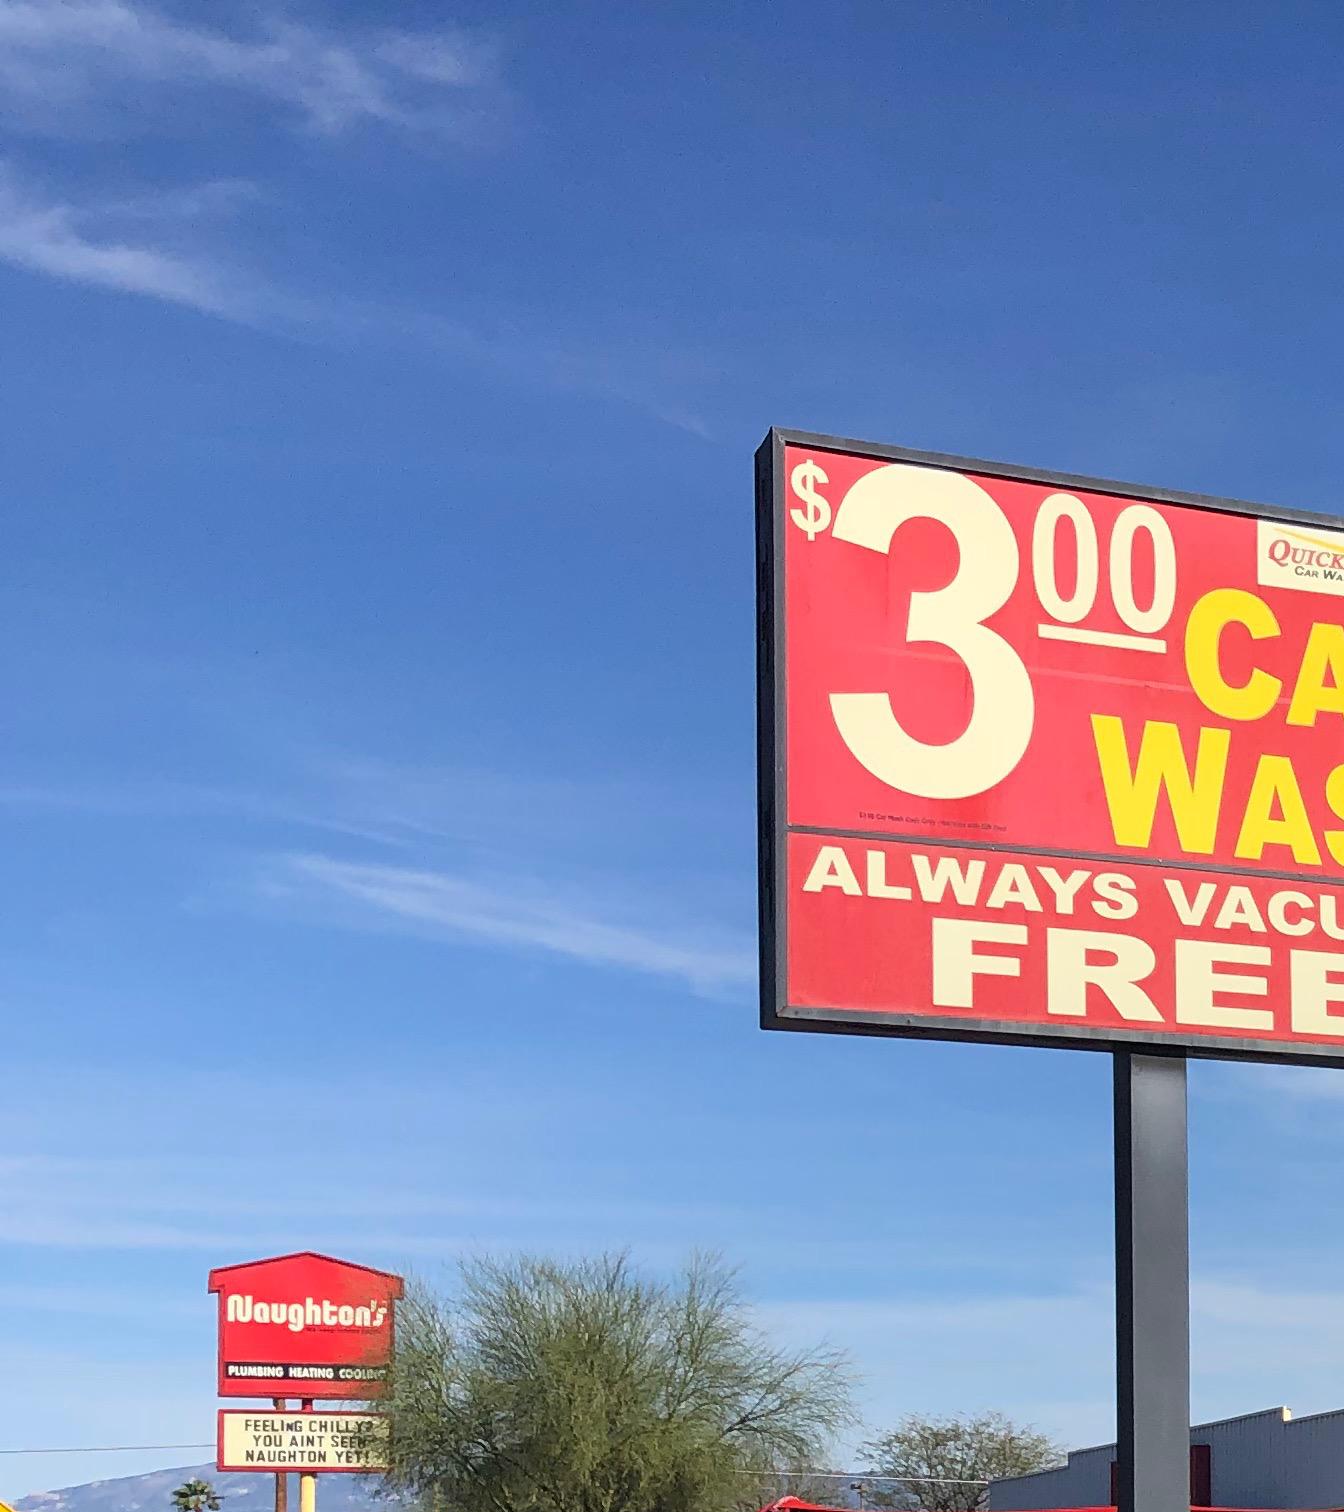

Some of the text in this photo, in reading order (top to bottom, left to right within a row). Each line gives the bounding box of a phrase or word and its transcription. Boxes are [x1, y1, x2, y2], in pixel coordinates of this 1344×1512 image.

[1294, 565, 1319, 578] CAR
[803, 846, 1138, 920] ALWAYS
[227, 1293, 388, 1332] Naughton's
[228, 1365, 284, 1378] PLUMBING
[289, 1366, 335, 1379] HEATING
[244, 1419, 303, 1433] FEELING
[253, 1435, 283, 1448] YOU
[289, 1435, 325, 1448] AINT
[245, 1450, 326, 1463] NAUGHTON
